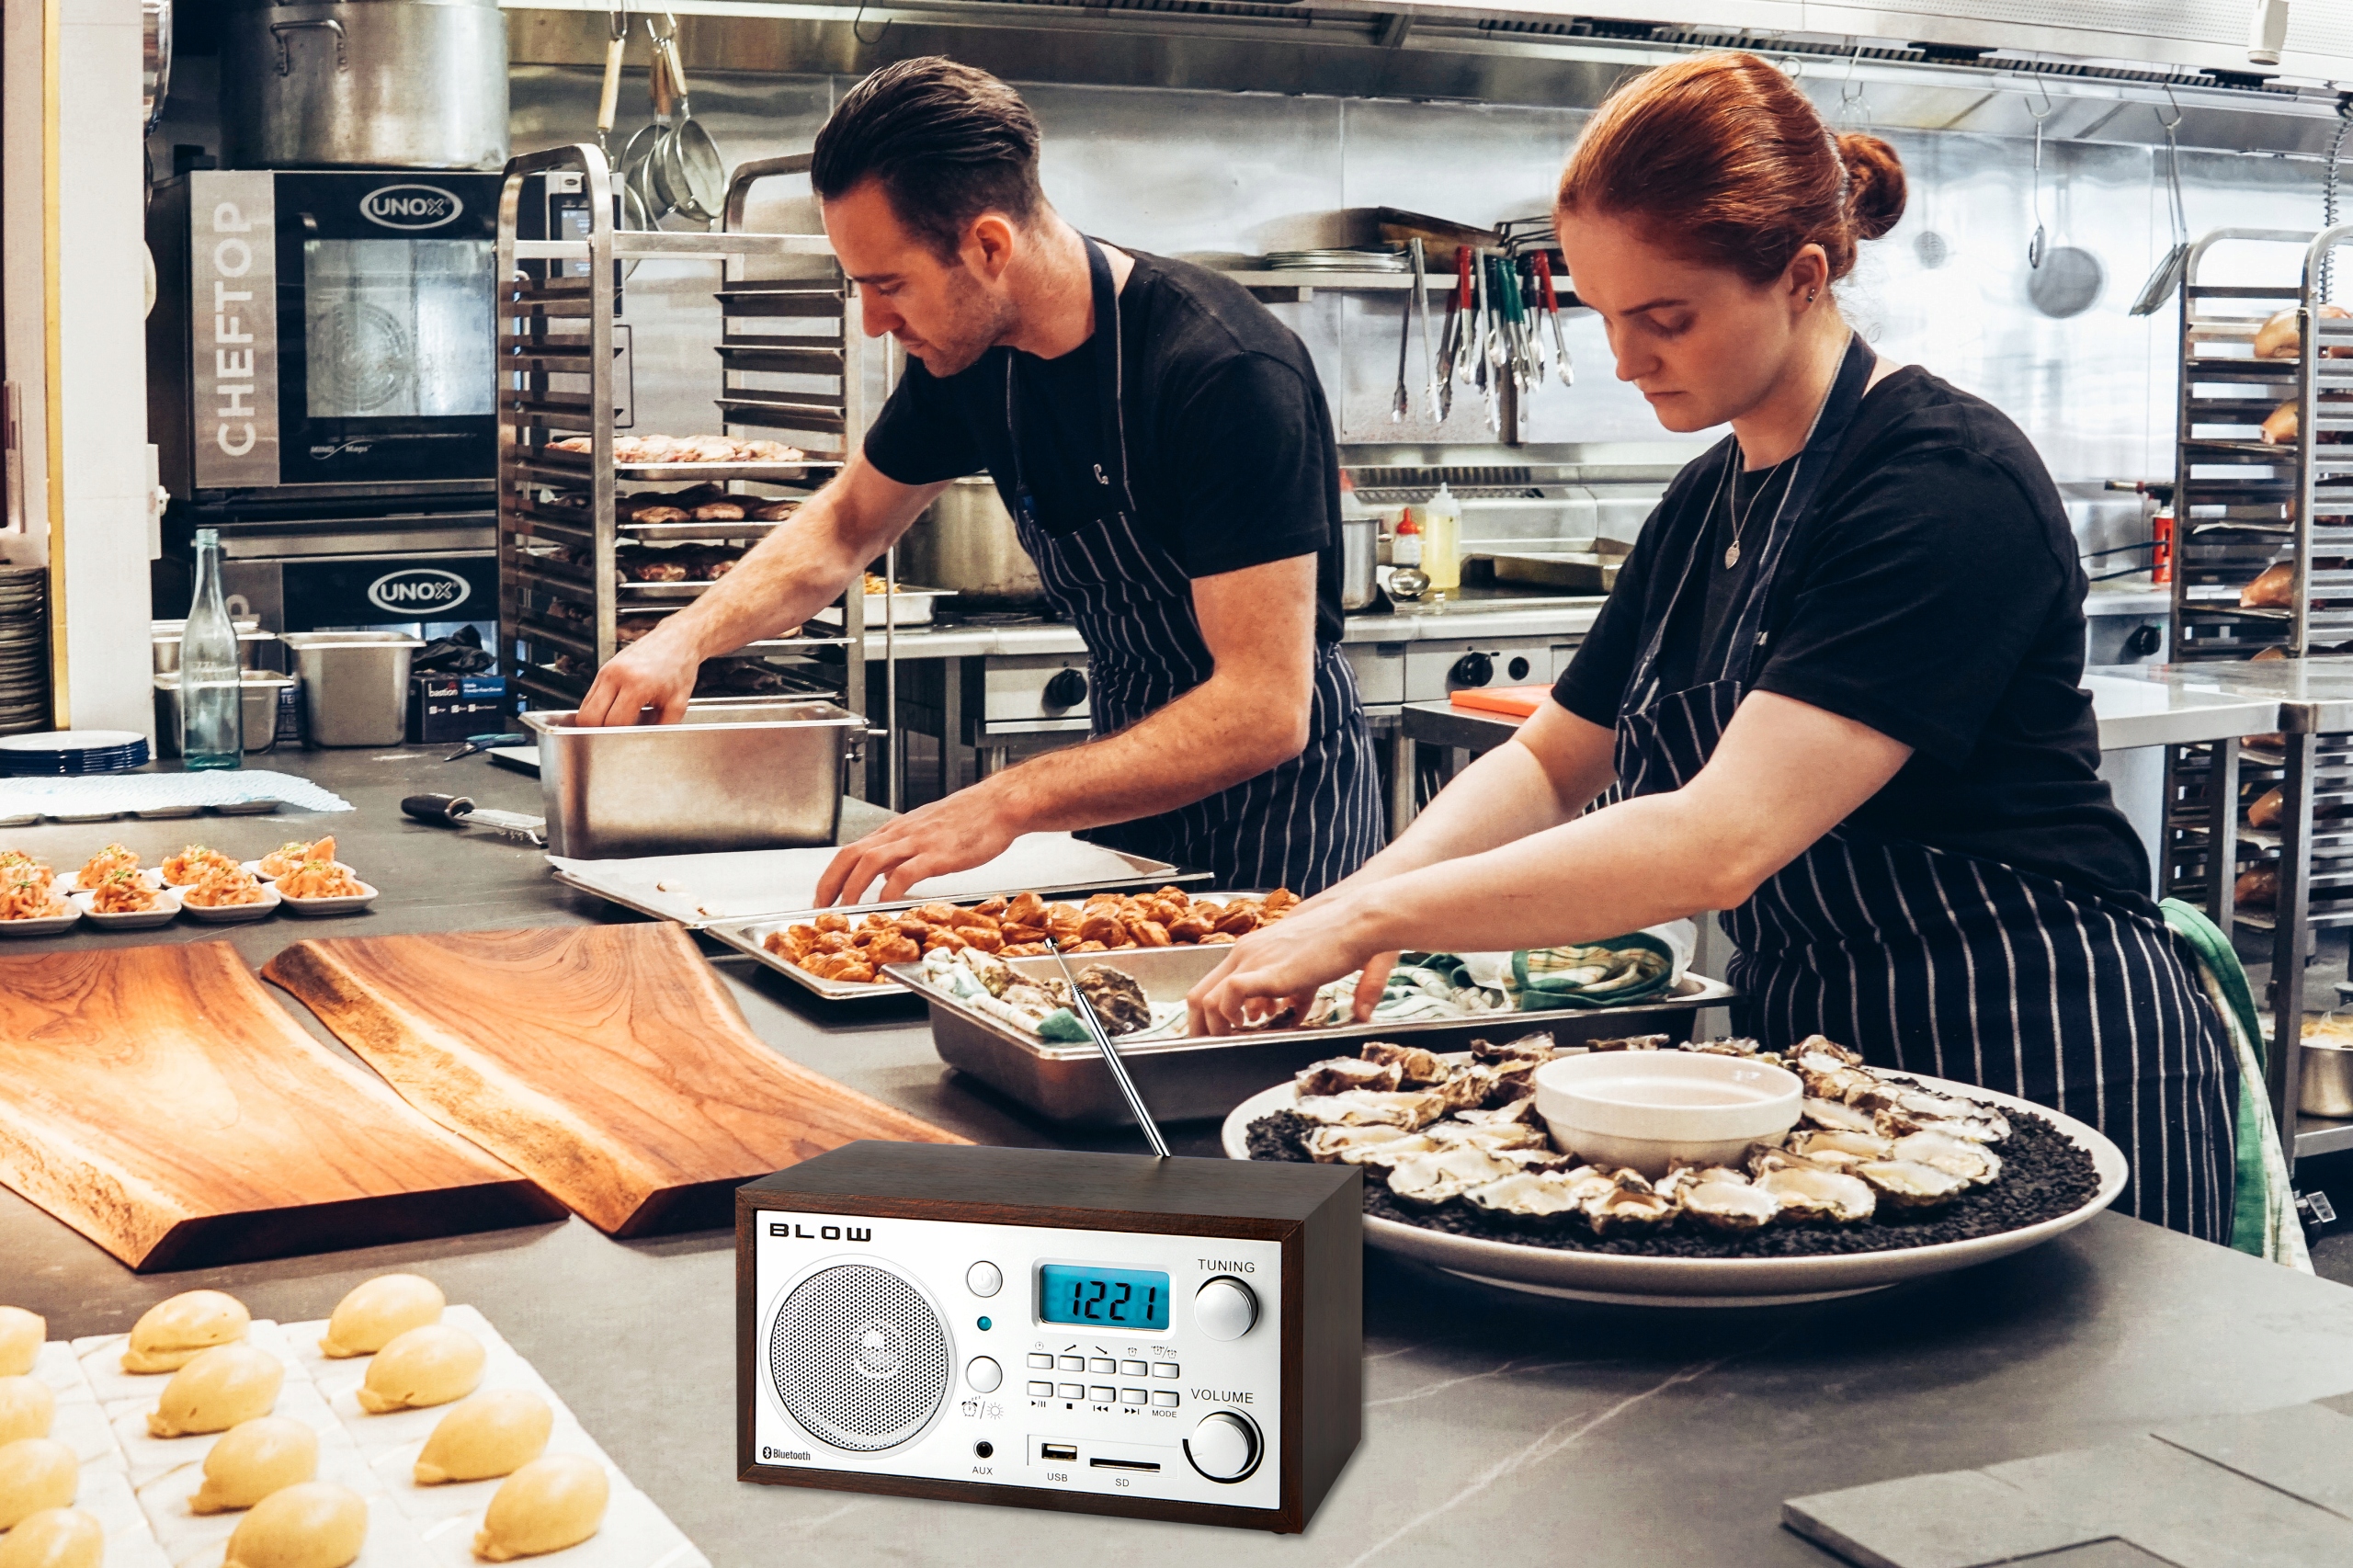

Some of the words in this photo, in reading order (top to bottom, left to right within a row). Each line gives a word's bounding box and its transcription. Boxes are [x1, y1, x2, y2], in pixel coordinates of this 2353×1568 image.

[372, 198, 445, 216] UNOX
[213, 202, 256, 457] CHEFTOP
[381, 582, 452, 601] UNOX
[769, 1222, 871, 1243] BLOW
[1198, 1258, 1256, 1273] TUNING
[1073, 1280, 1155, 1321] 1221
[1190, 1388, 1254, 1404] VOLUME
[1152, 1409, 1177, 1419] MODE
[773, 1449, 811, 1461] Bluetooth
[972, 1465, 993, 1476] AUX
[1047, 1472, 1068, 1483] USB
[1115, 1478, 1130, 1487] SD
